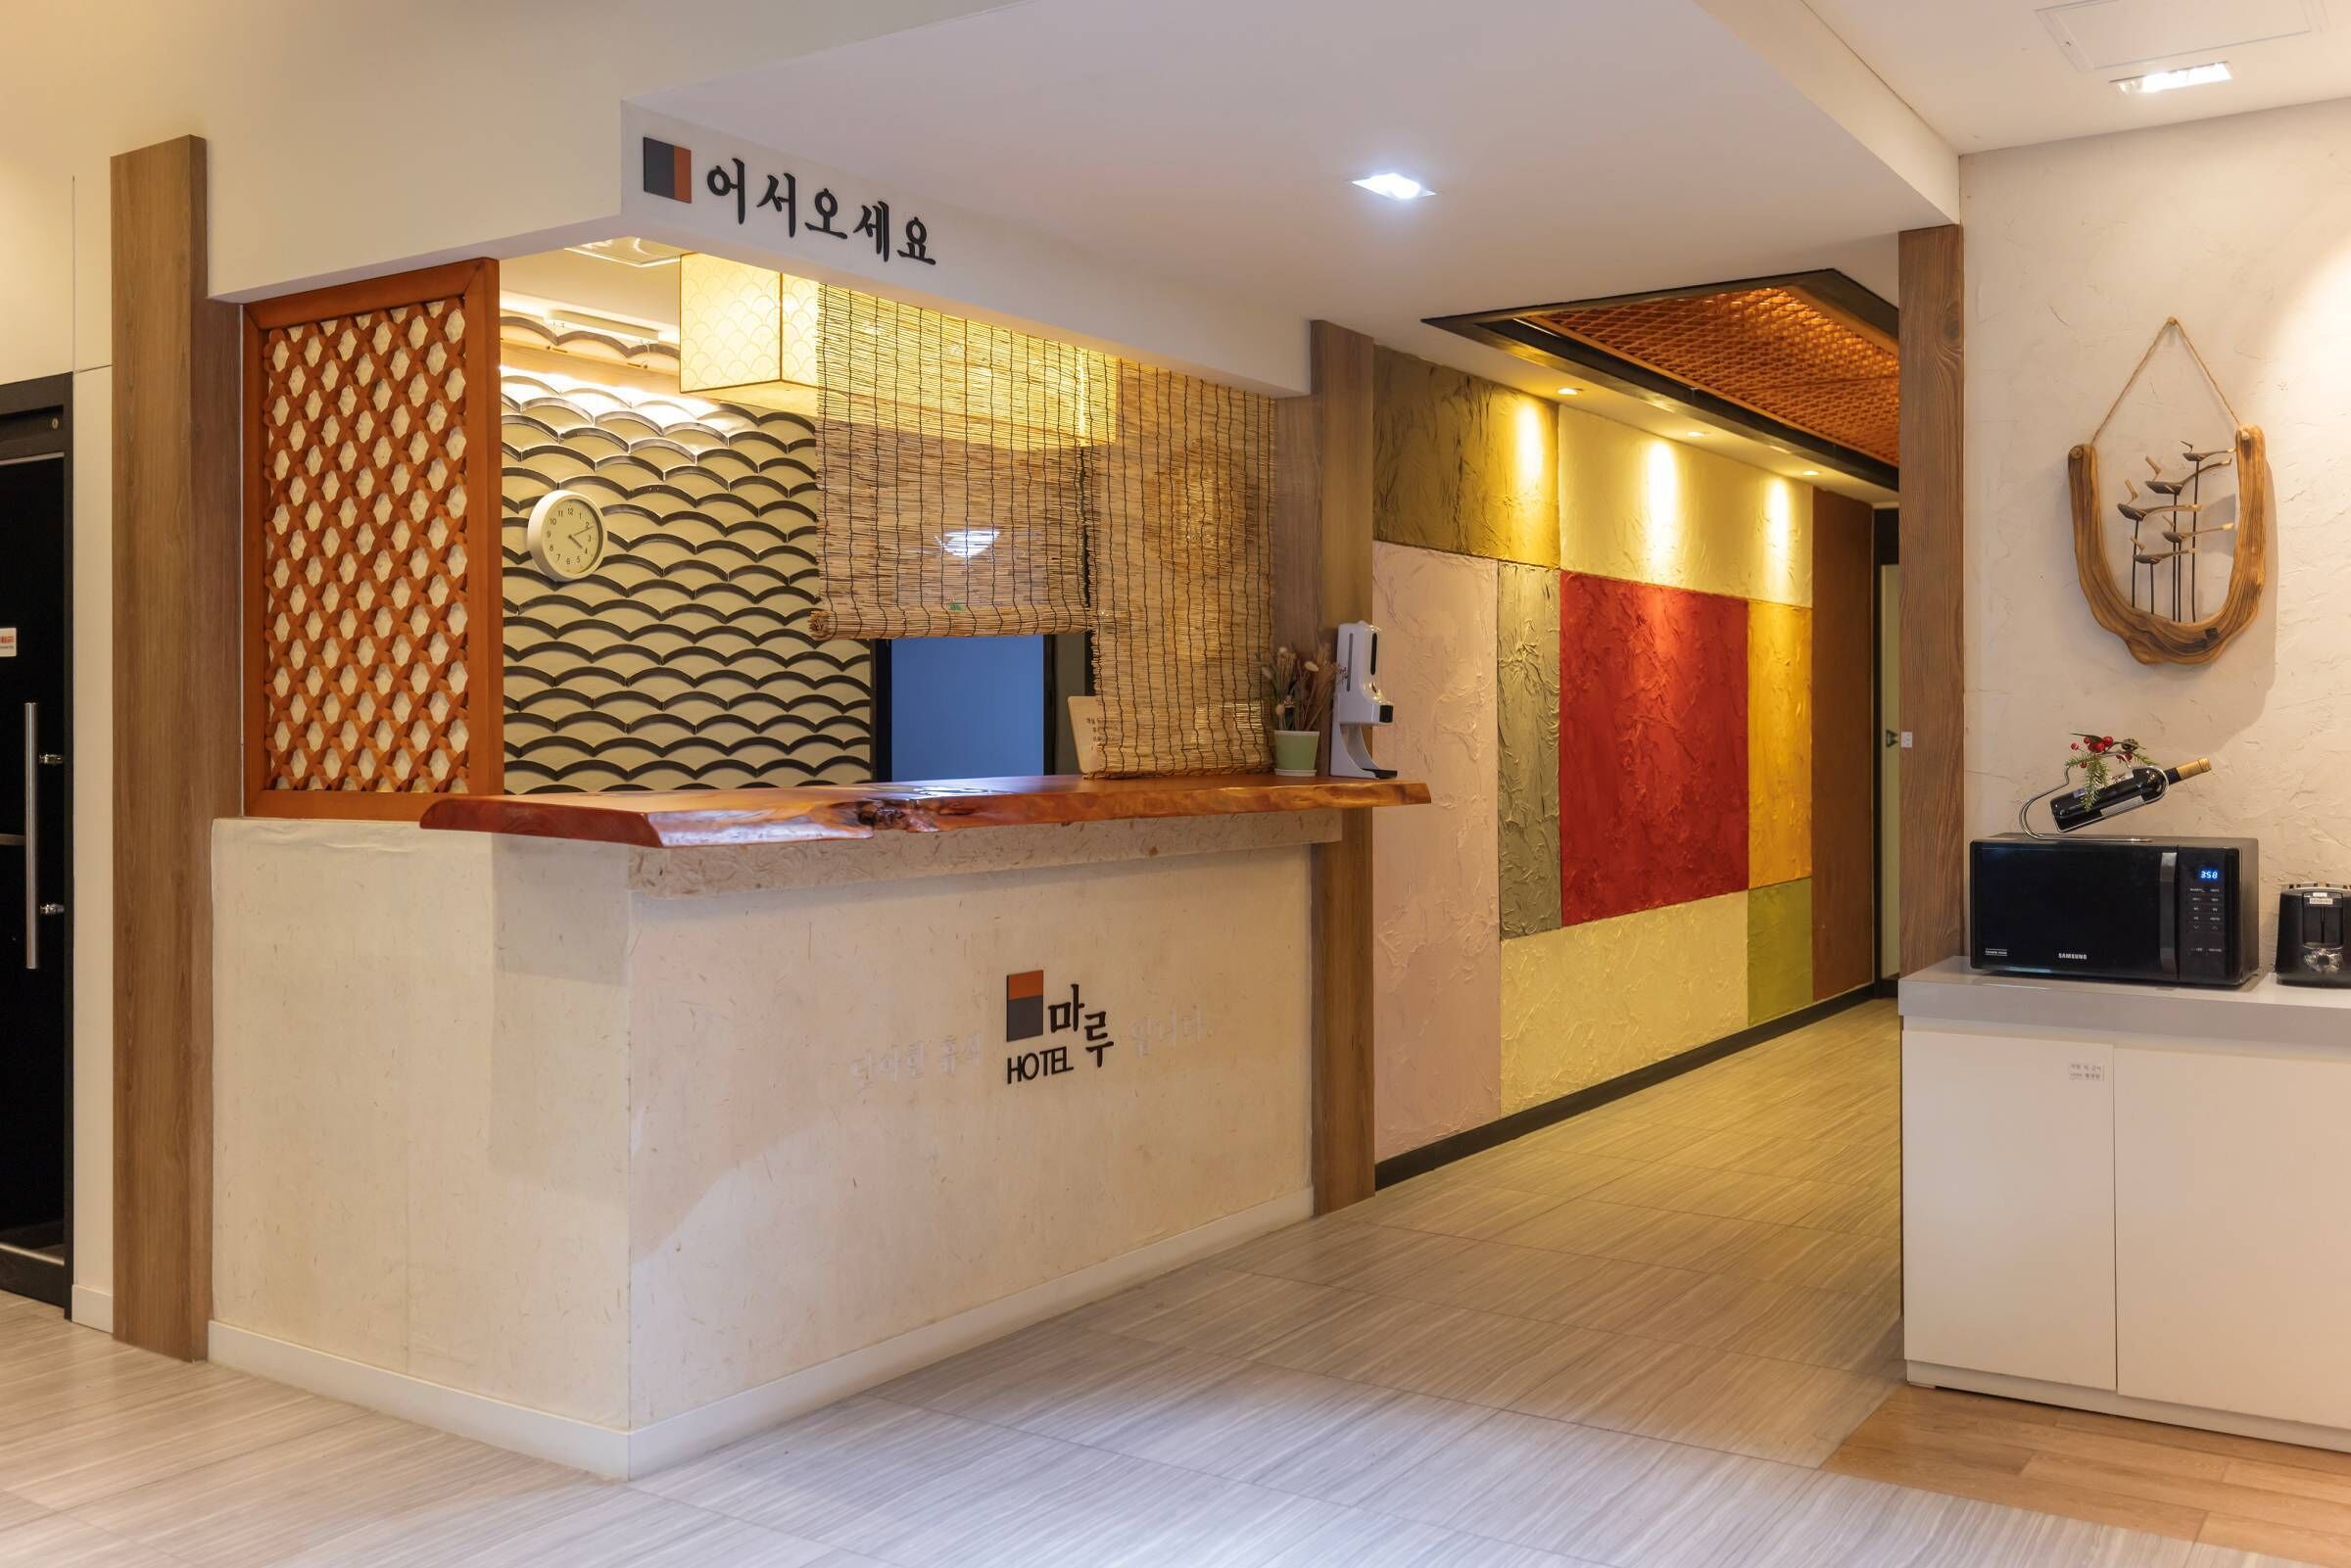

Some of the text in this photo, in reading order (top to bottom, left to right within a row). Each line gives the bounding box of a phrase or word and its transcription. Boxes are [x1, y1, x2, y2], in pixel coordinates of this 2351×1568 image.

[707, 158, 936, 265] 어서오세요
[1006, 1046, 1074, 1084] HOTEL
[1047, 983, 1114, 1068] 마루
